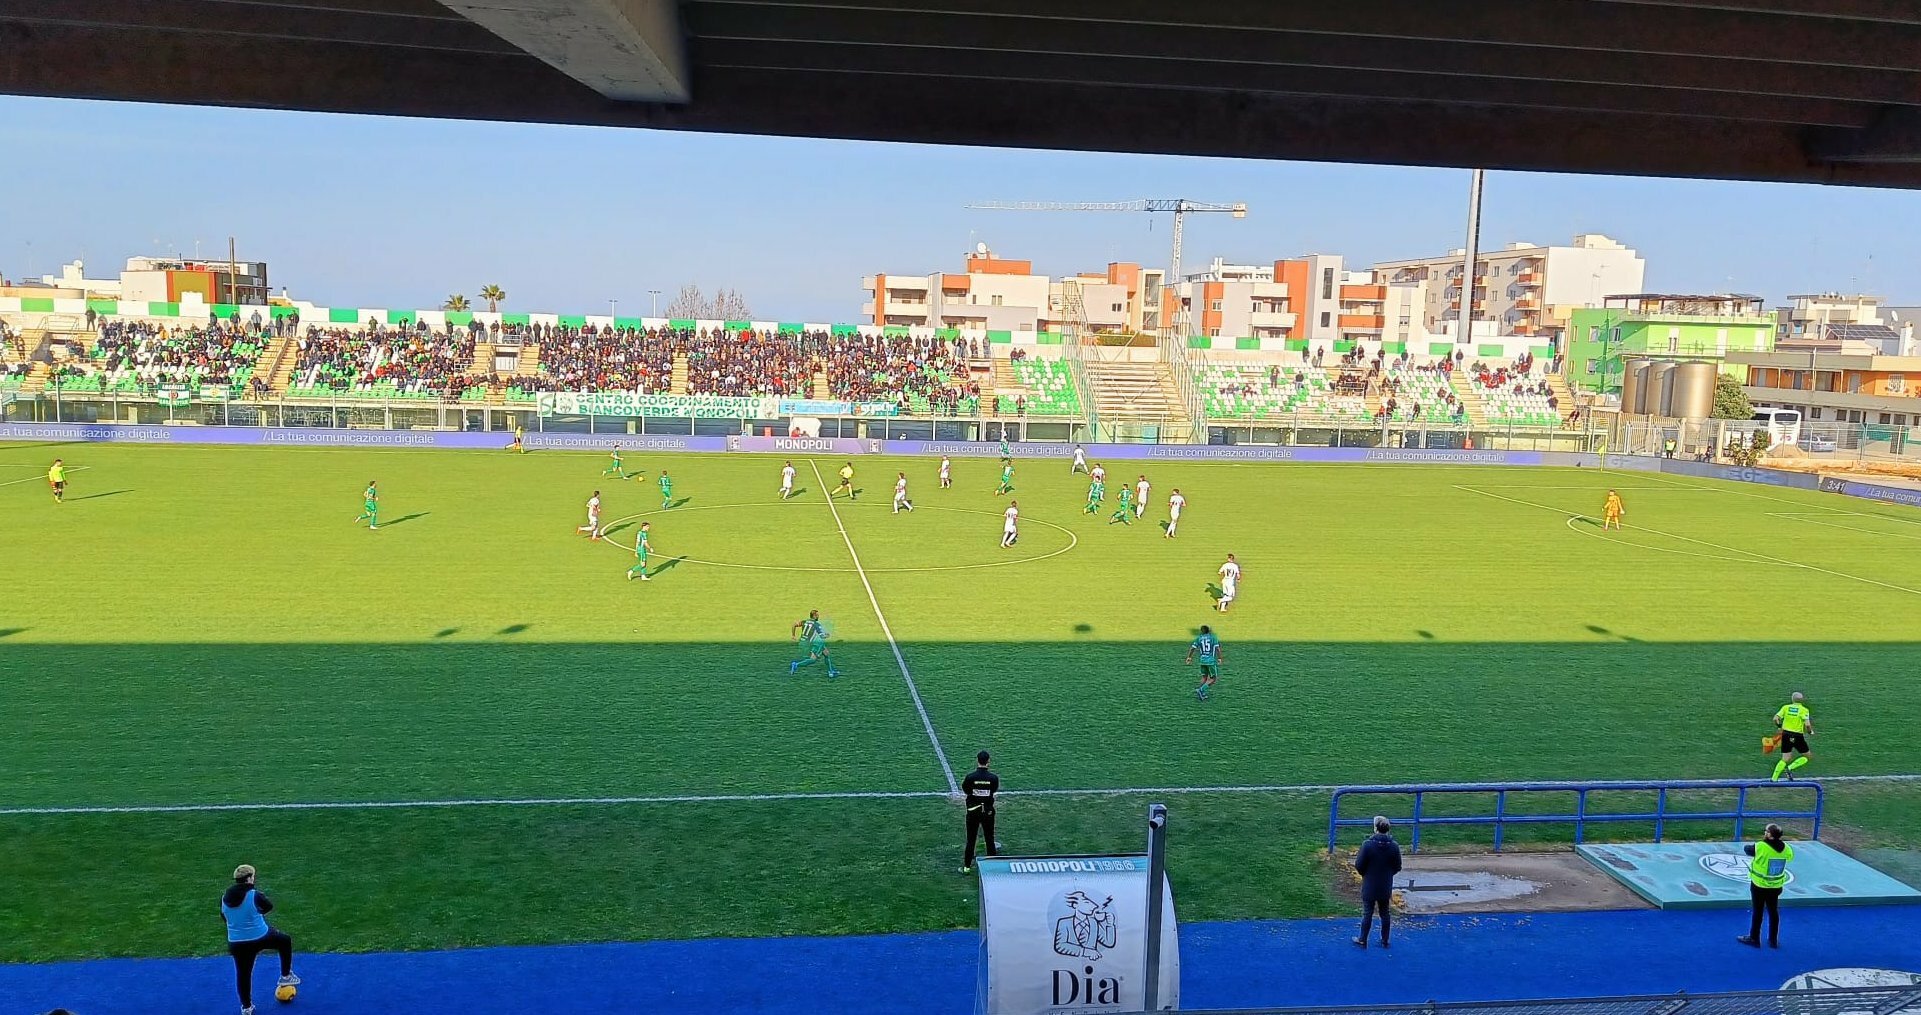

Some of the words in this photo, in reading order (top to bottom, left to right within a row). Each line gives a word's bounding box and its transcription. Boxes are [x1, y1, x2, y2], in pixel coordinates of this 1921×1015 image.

[576, 394, 633, 406] CENTRO
[638, 395, 760, 409] COORDINAMENTO
[579, 405, 680, 417] BIANCOVERDE
[684, 407, 758, 419] MONOPOLI
[13, 428, 33, 437] tua
[36, 428, 124, 438] comunicazione
[128, 429, 170, 440] digitale
[288, 432, 306, 442] tua
[309, 432, 391, 444] comunicazione
[395, 433, 434, 445] digitale
[545, 437, 562, 446] tua
[566, 437, 644, 448] comunicazione
[648, 438, 686, 450] digitale
[776, 439, 833, 451] MONOPOLI
[943, 444, 958, 453] tua
[1037, 445, 1070, 456] digitale
[1168, 448, 1183, 457] tua
[1186, 448, 1255, 458] comunicazione
[1259, 449, 1291, 460] digitale
[1386, 451, 1400, 460] tua
[1403, 452, 1469, 463] comunicazione
[1827, 480, 1845, 492] 3:41
[1882, 490, 1895, 499] tua
[1201, 639, 1211, 652] 15
[1010, 860, 1096, 873] MONOPOLI
[1097, 860, 1136, 872] 1966
[1050, 965, 1121, 1006] Dia
